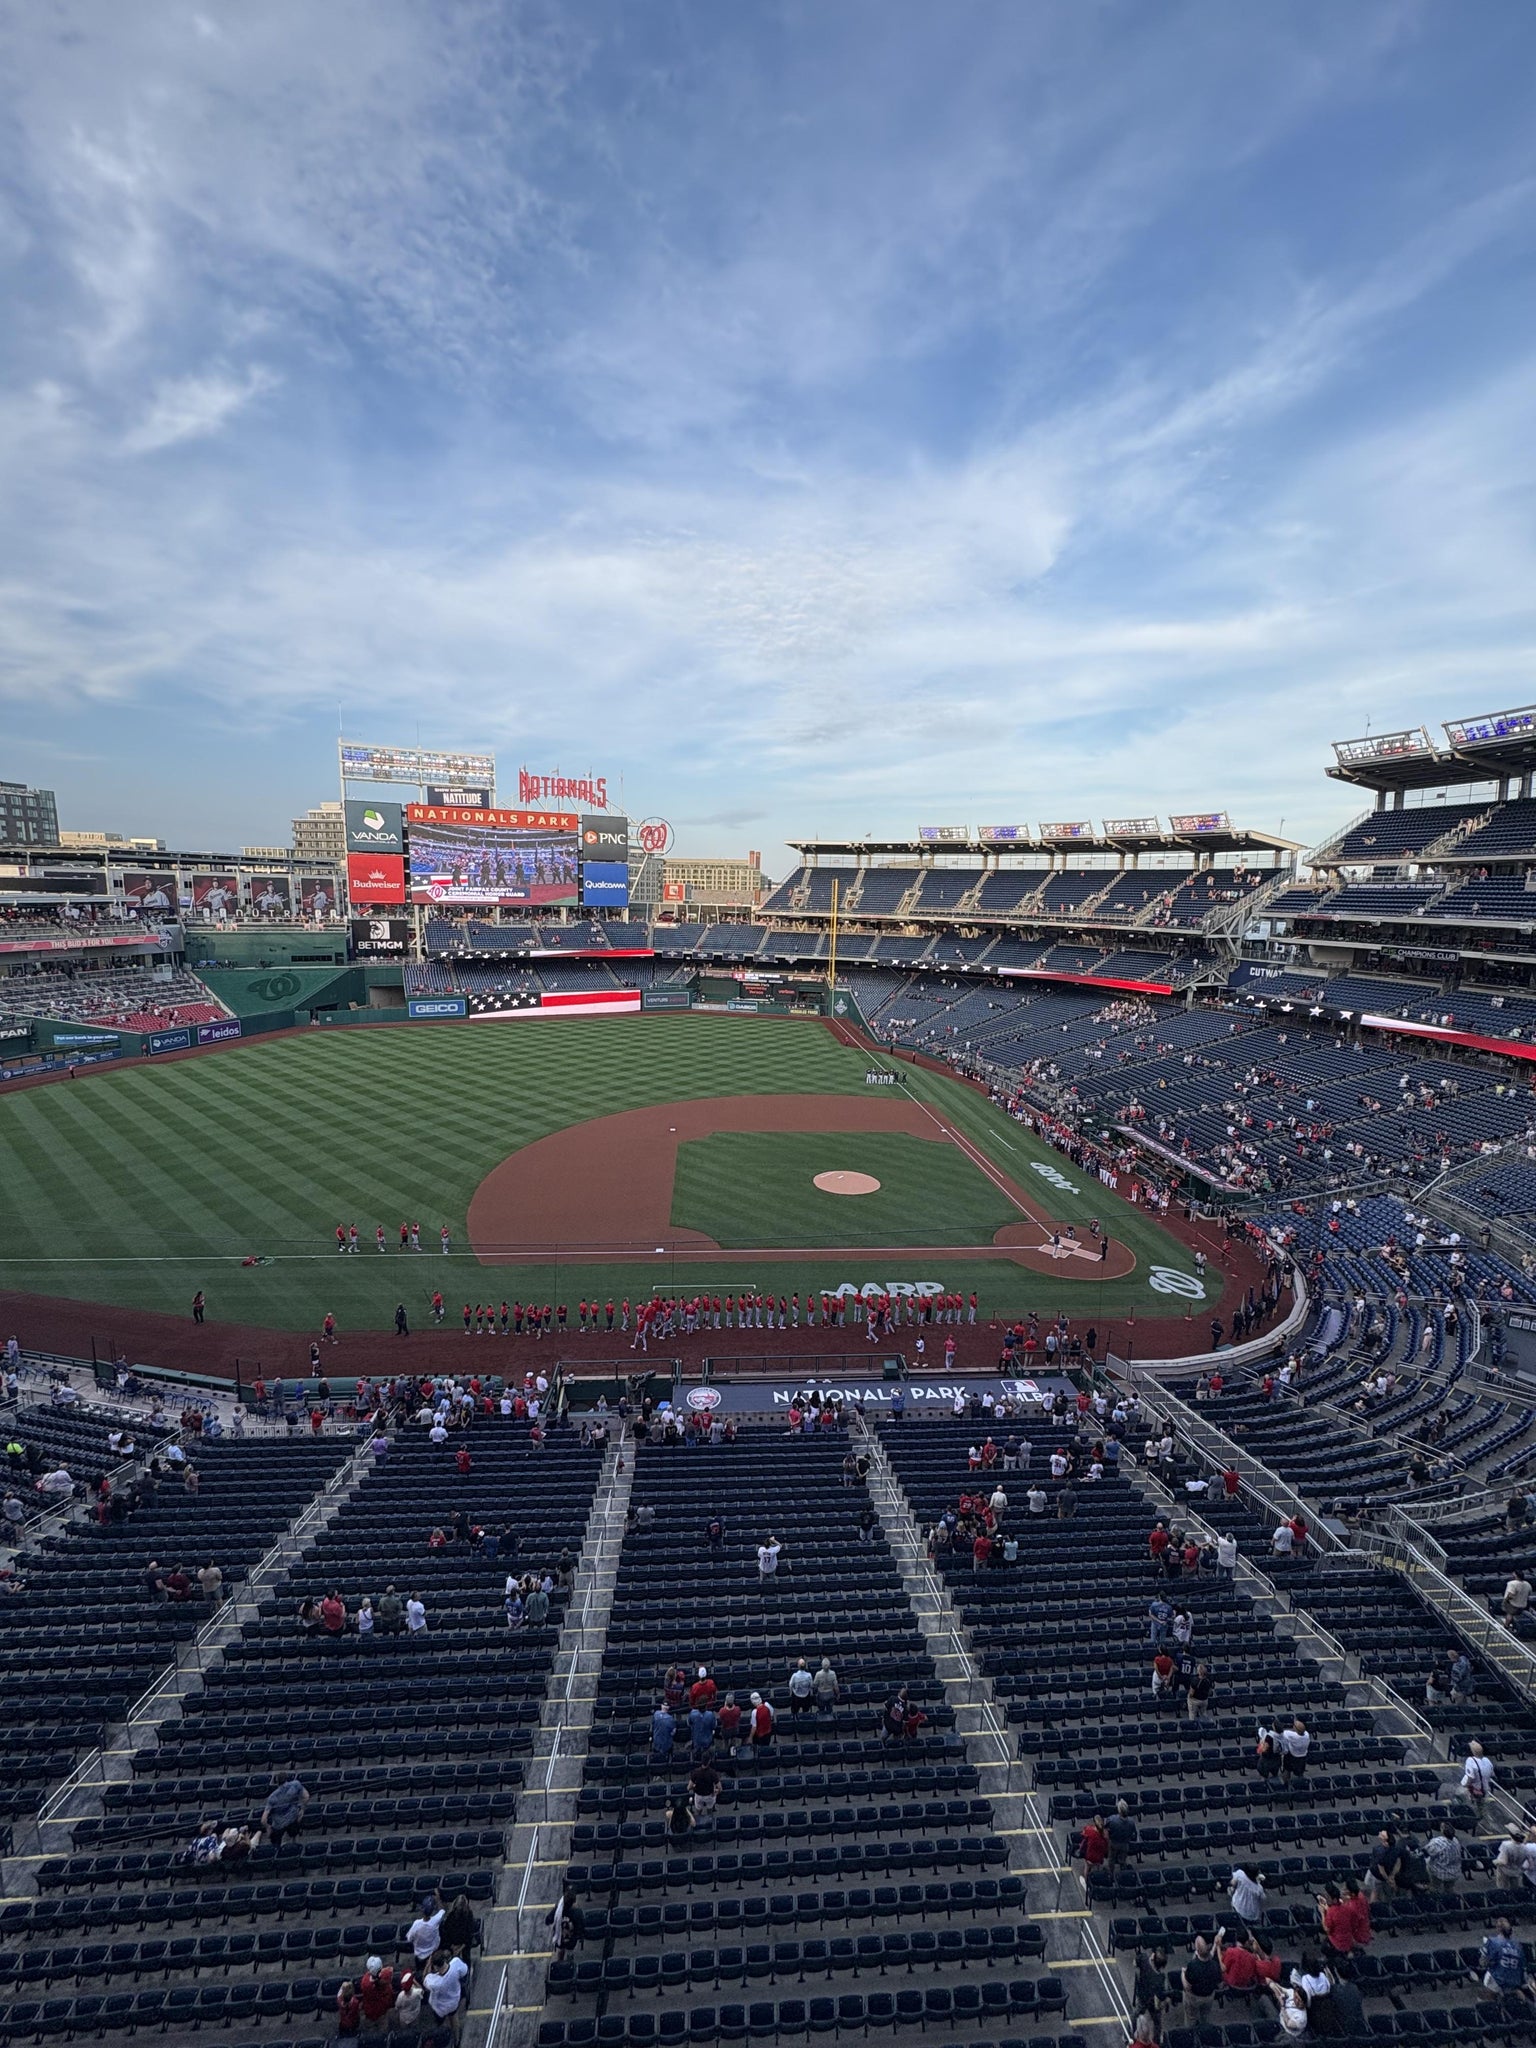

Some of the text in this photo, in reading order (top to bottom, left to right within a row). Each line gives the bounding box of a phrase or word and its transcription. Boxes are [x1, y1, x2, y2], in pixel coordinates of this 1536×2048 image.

[519, 769, 607, 808] NATIONALS
[443, 792, 482, 804] NATITUDE
[414, 808, 570, 826] NATIONALS PARK
[352, 832, 398, 841] VANDA
[599, 832, 627, 844] PNC
[353, 880, 401, 889] Budweiser
[585, 880, 627, 889] Qualcomm
[358, 941, 403, 950] BETMGM
[1398, 949, 1436, 959] CHAMPIONS
[1437, 952, 1456, 960] CLUB
[416, 1003, 458, 1013] GEICO
[0, 1028, 27, 1038] FAN
[212, 1027, 240, 1039] leidos
[161, 1036, 187, 1044] VANDA
[1030, 1162, 1081, 1194] AARP
[820, 1282, 945, 1299] AARP
[773, 1386, 971, 1403] NATIONALS PARK
[1181, 1664, 1192, 1674] 10
